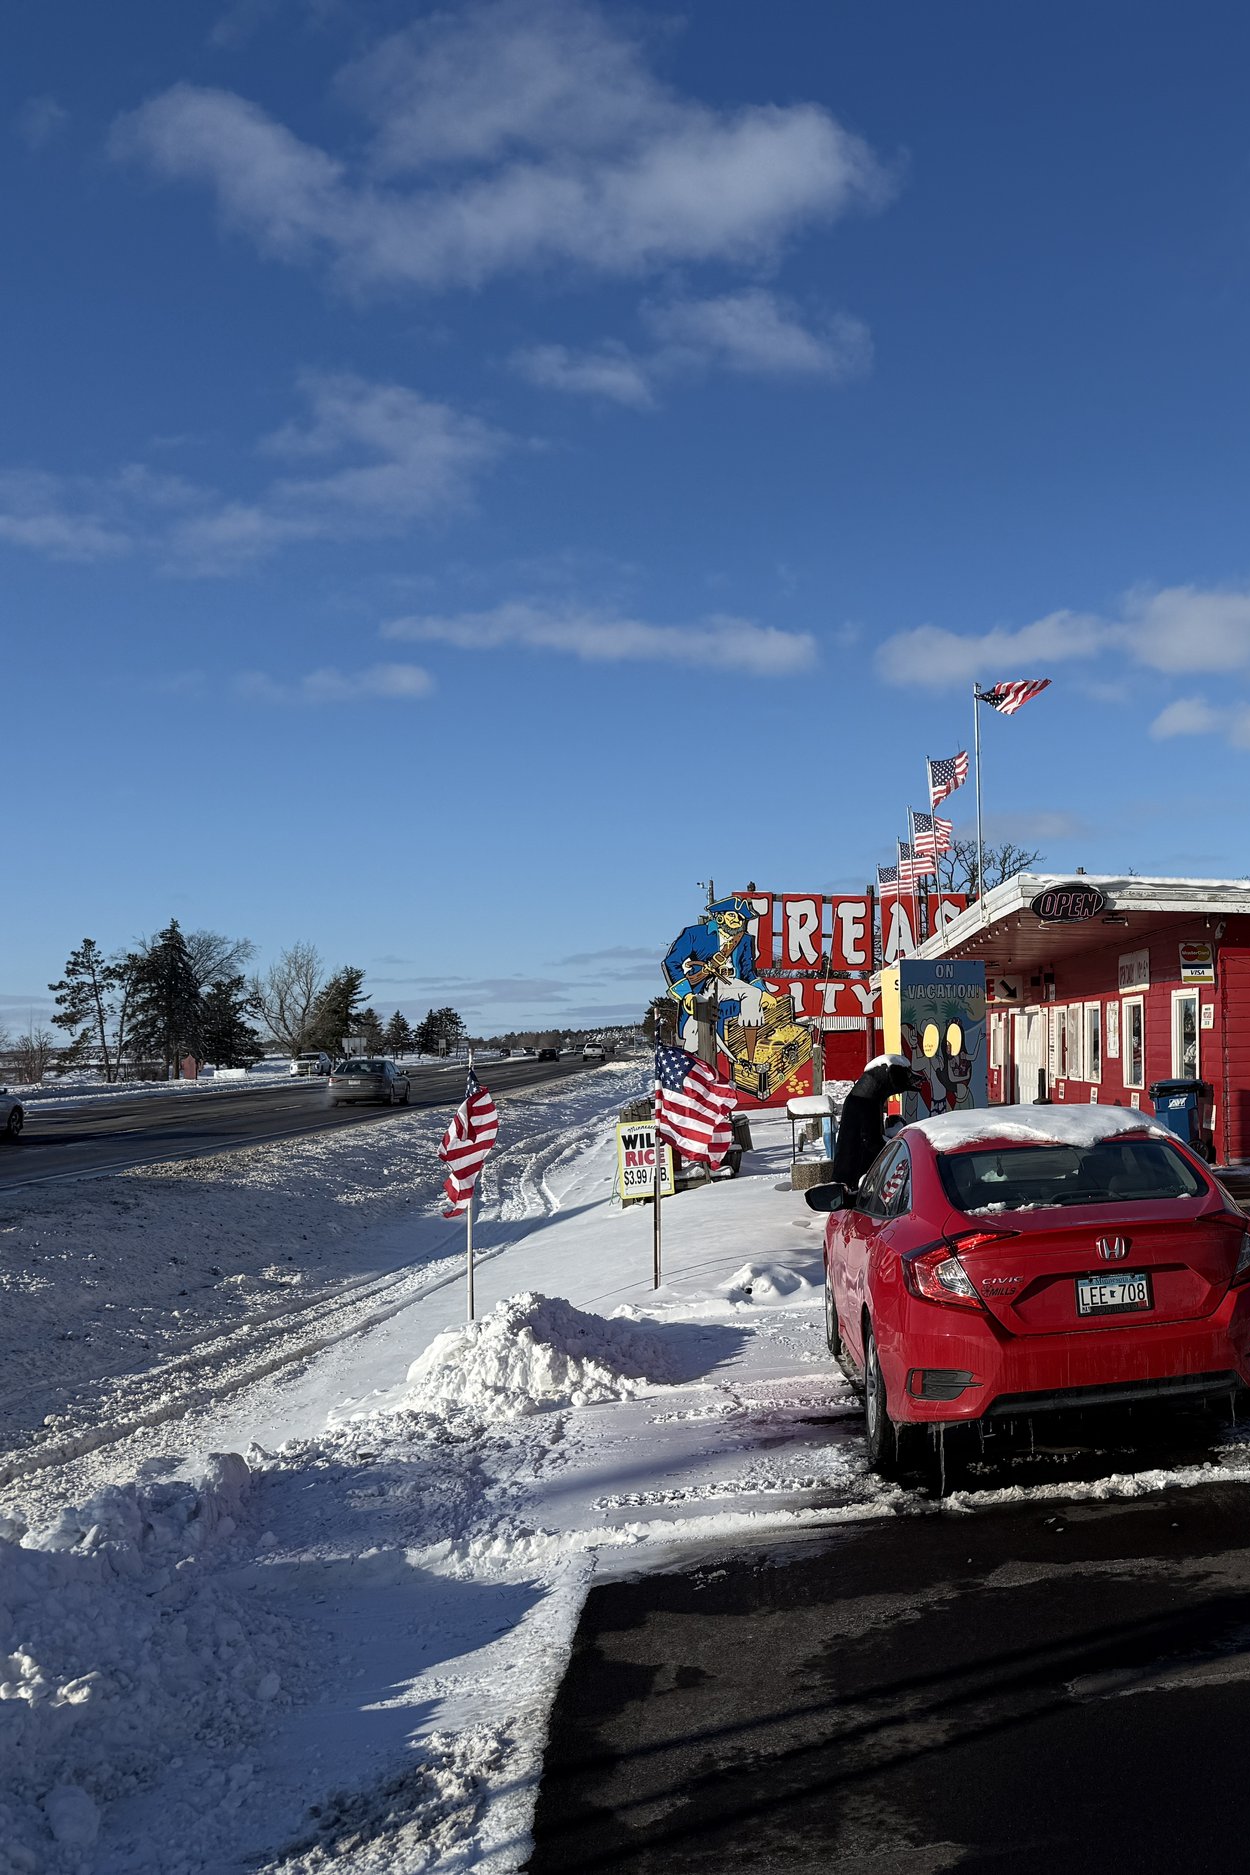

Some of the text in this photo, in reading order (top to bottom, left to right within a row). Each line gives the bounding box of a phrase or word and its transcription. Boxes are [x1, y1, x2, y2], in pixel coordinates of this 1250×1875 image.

[1040, 892, 1098, 917] OPEN
[935, 963, 954, 979] ON
[907, 983, 980, 1000] VACATION!
[624, 1169, 647, 1186] $3.99
[982, 1275, 1024, 1285] CIVIC
[989, 1286, 1017, 1298] MILLS
[1080, 1282, 1146, 1306] LEE 708
